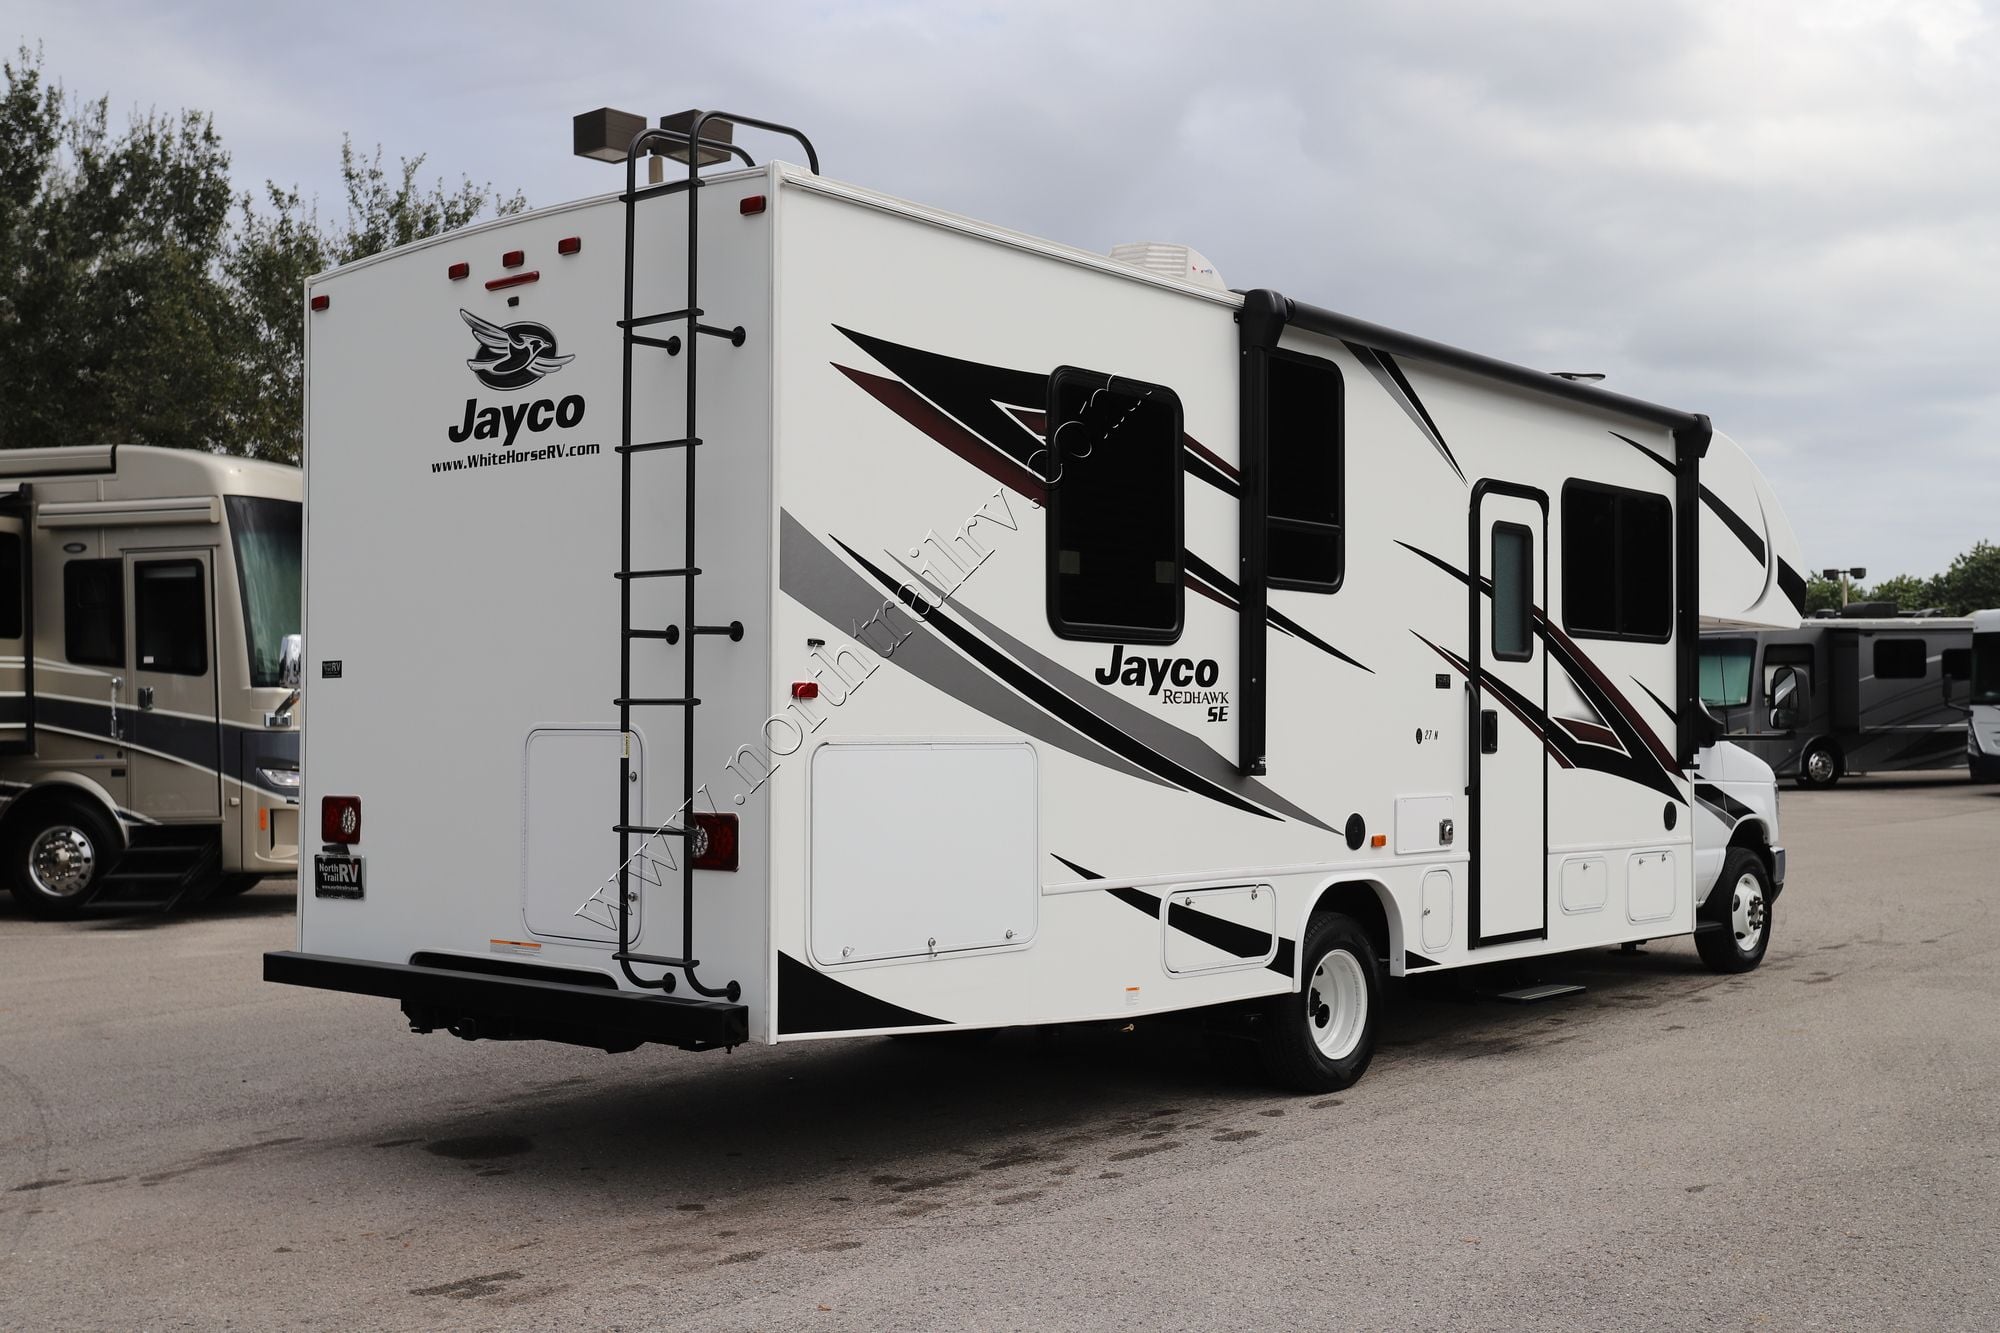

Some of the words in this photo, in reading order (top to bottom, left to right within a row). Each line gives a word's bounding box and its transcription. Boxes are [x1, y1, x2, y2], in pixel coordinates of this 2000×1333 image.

[448, 394, 586, 446] Jayco
[431, 443, 600, 473] www.WhiteHorseRV.com
[1095, 644, 1219, 696] Jayco
[1207, 706, 1229, 723] SE
[1424, 729, 1433, 741] 27
[319, 863, 338, 872] North
[338, 863, 359, 883] RV
[323, 872, 339, 882] Trail
